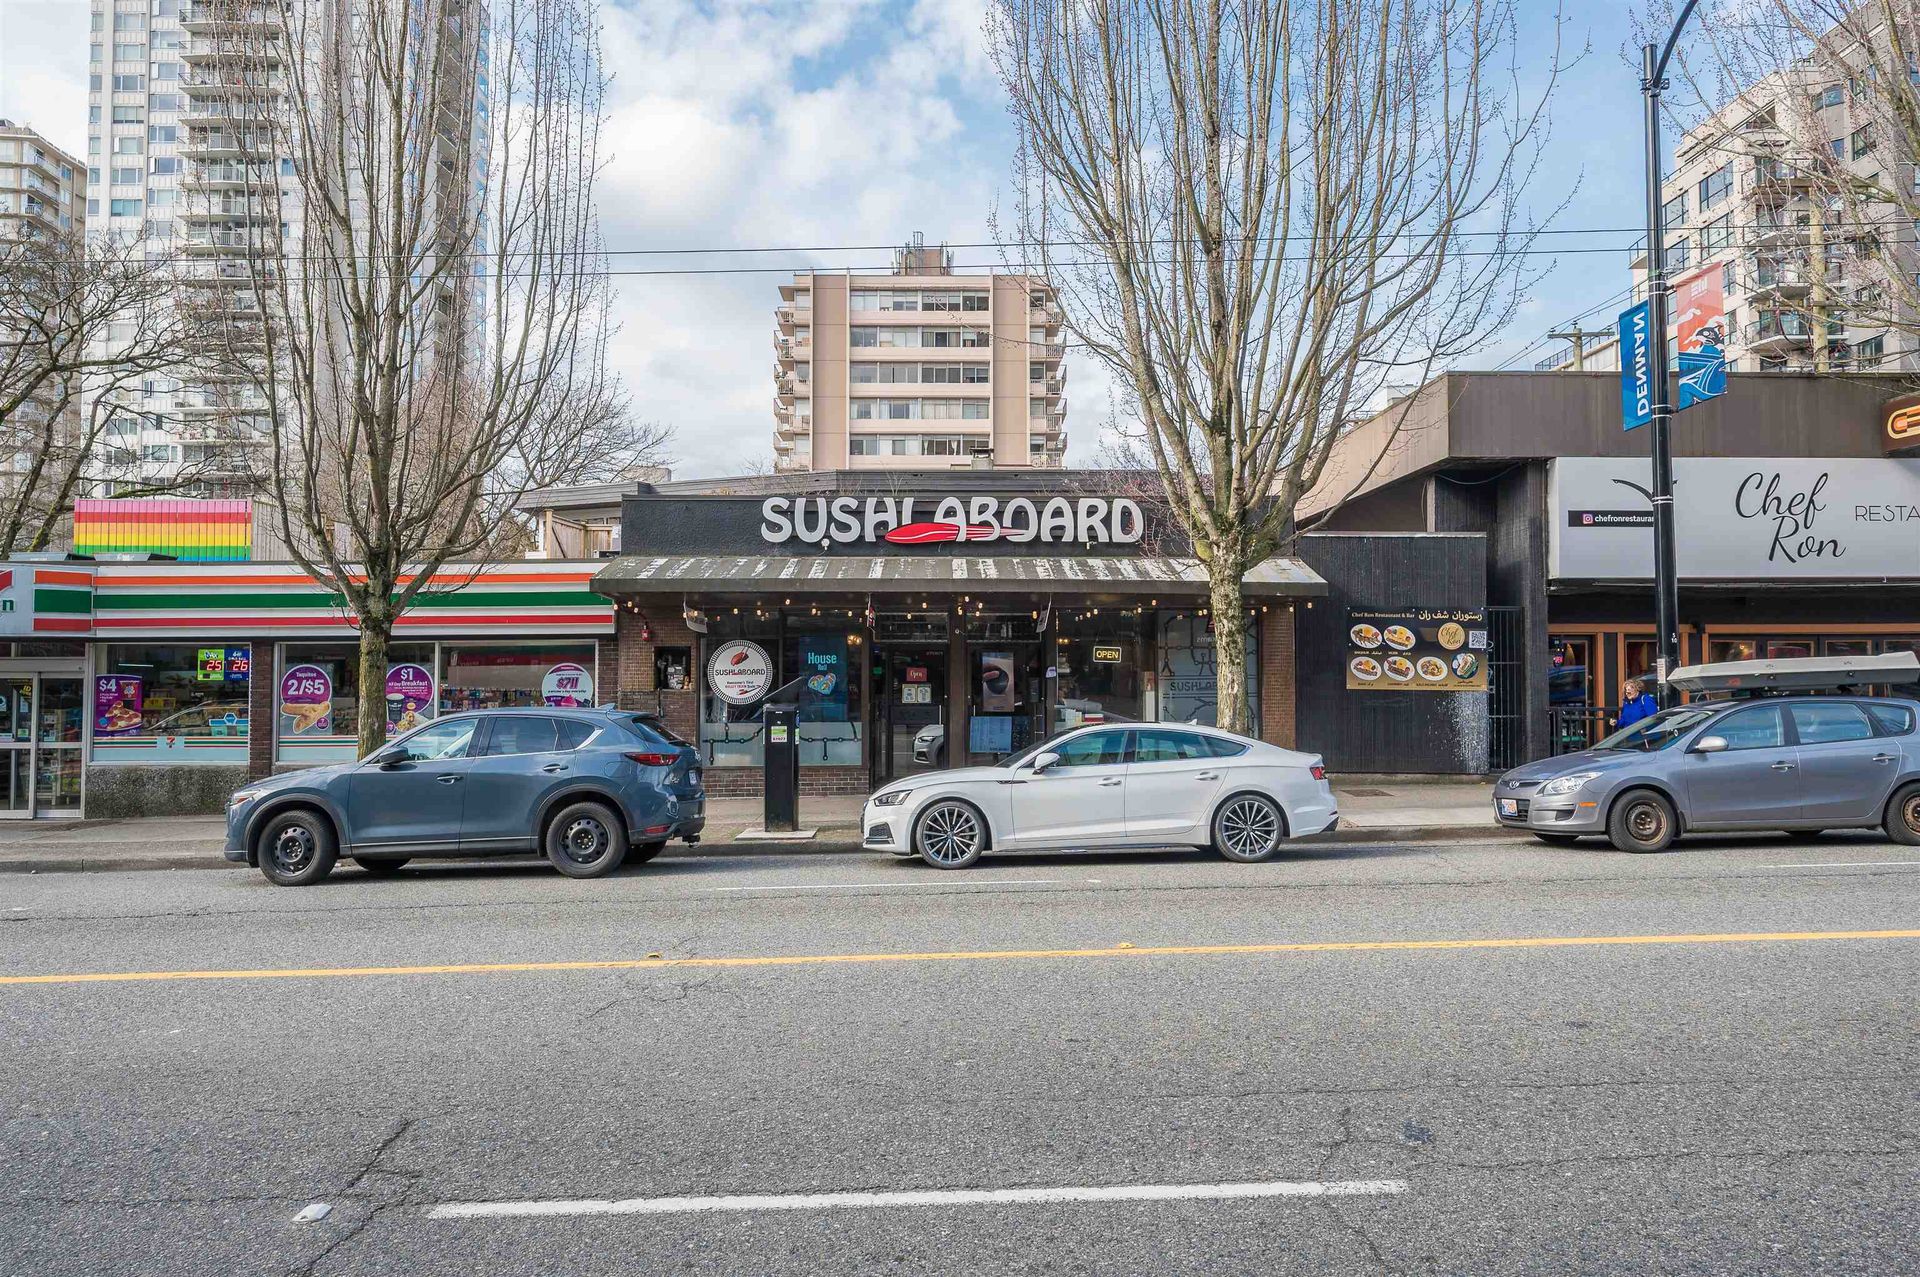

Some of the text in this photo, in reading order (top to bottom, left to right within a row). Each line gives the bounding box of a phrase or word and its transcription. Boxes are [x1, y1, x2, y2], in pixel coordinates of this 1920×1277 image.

[1735, 472, 1829, 530] Chef
[760, 497, 1144, 543] SUSHI ABOARD
[1855, 505, 1920, 522] RESTA
[1768, 515, 1847, 564] Ron
[807, 652, 837, 664] House
[1096, 650, 1119, 659] OPEN
[206, 660, 222, 671] 25
[232, 660, 248, 671] 26
[737, 668, 766, 676] ABOARD
[400, 668, 414, 680] $1
[99, 678, 117, 692] $4
[287, 679, 325, 696] 2/$5
